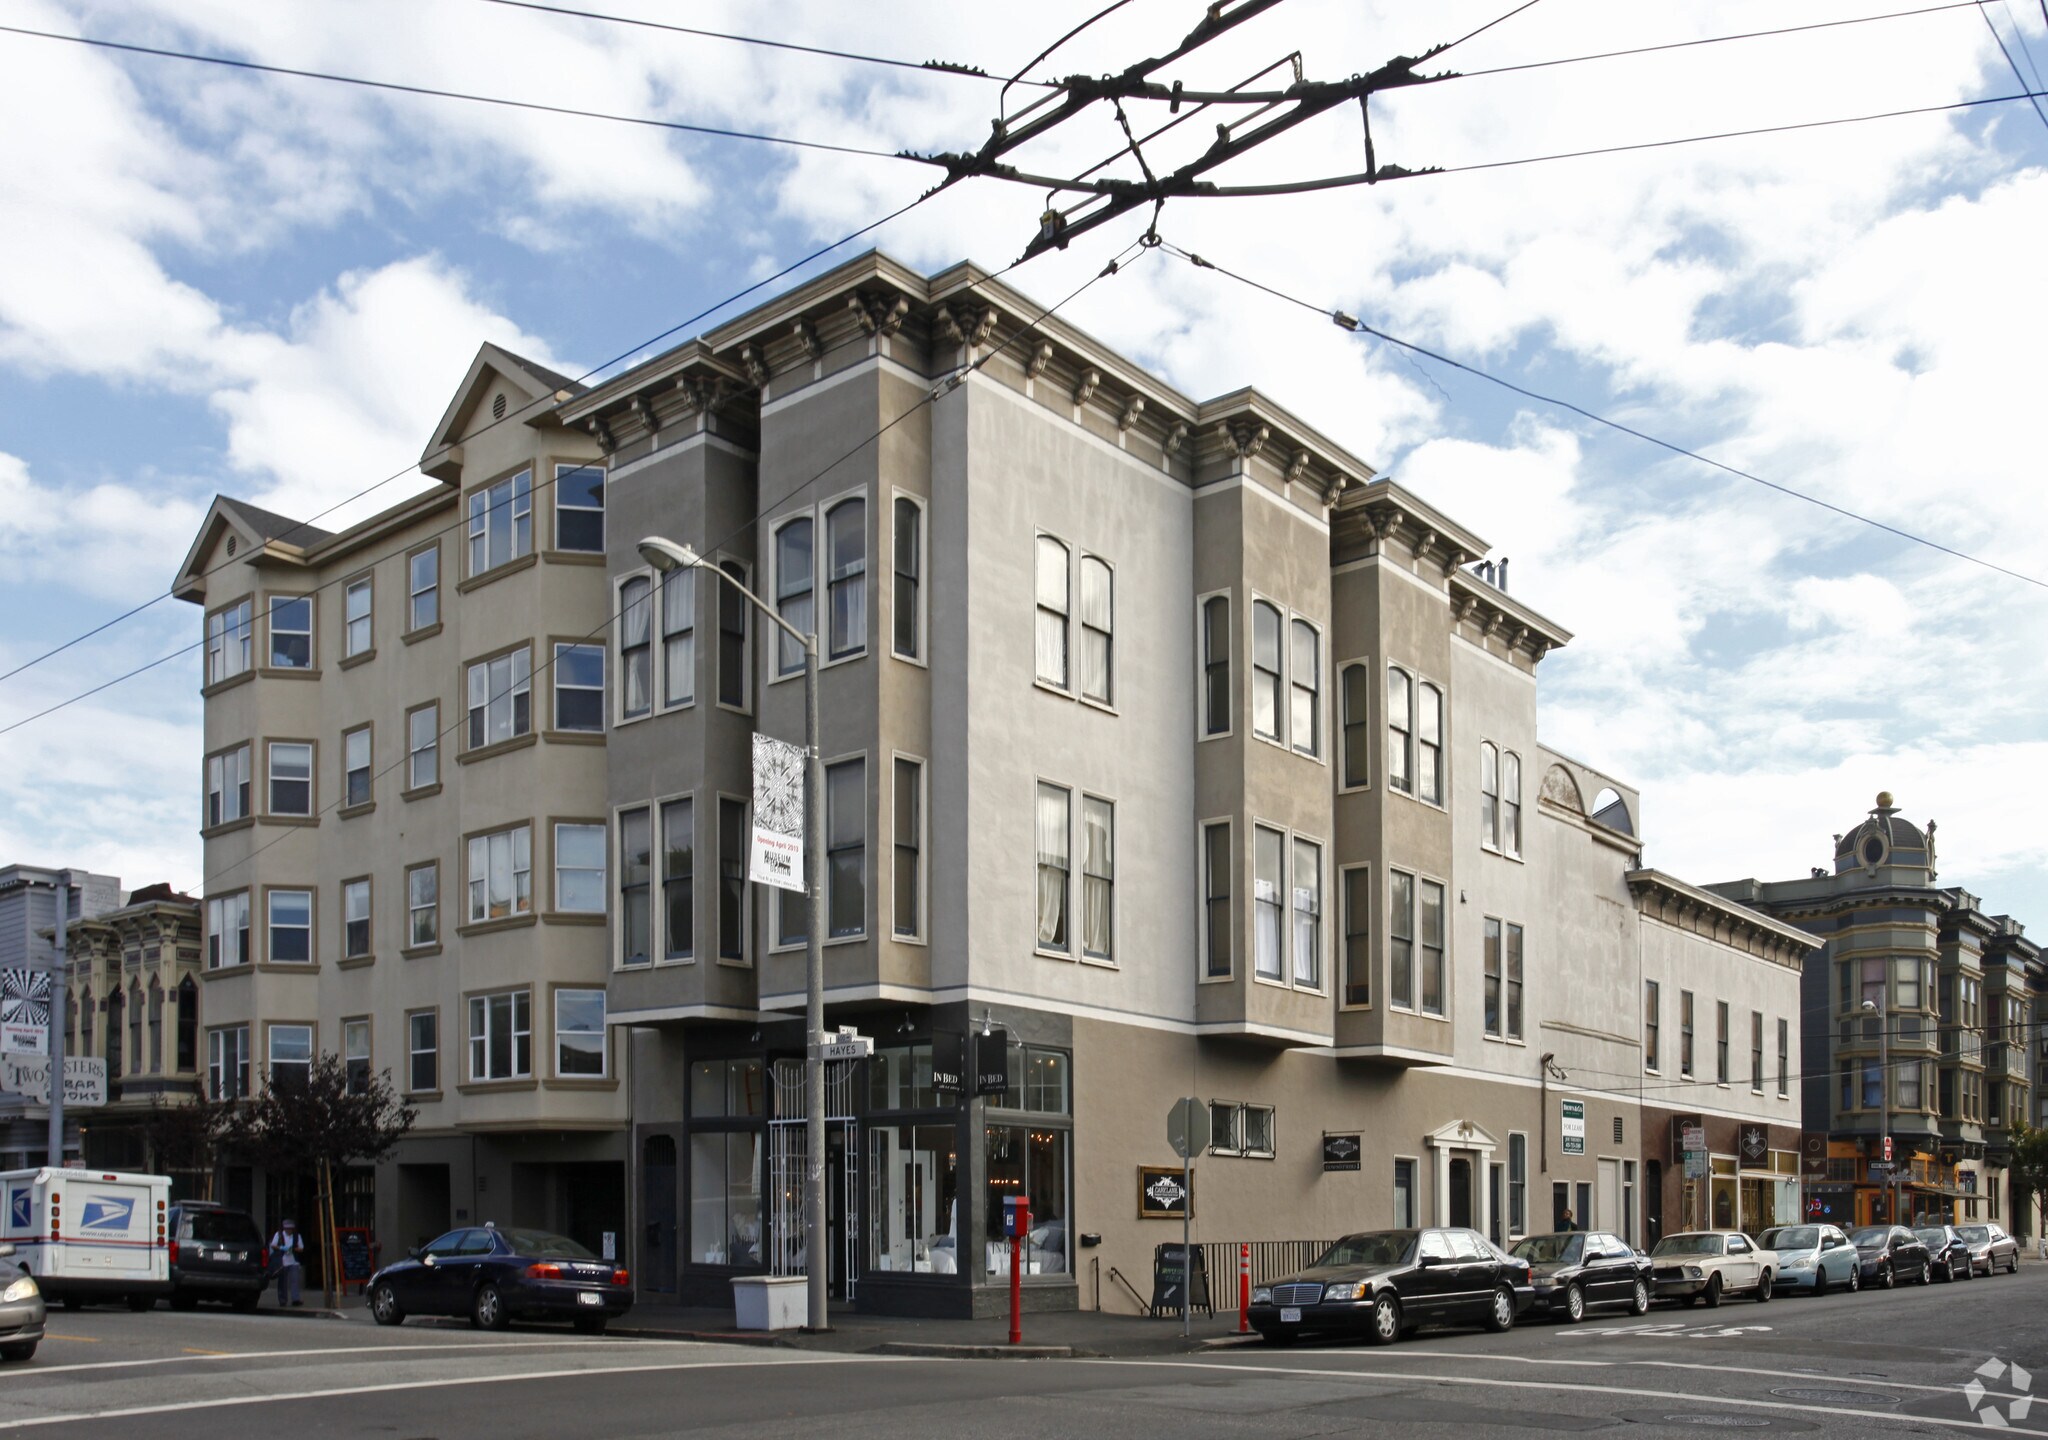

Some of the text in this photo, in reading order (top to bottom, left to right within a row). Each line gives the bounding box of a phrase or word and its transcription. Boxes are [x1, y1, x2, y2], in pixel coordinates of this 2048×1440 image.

[757, 835, 799, 853] Opening April 2013
[829, 1045, 856, 1057] HAYES
[933, 1071, 958, 1084] IN BED
[980, 1074, 1003, 1085] IN BED
[64, 1080, 96, 1089] BAR
[1563, 1123, 1583, 1132] FOR LEASE
[80, 1230, 129, 1239] www.usps.com
